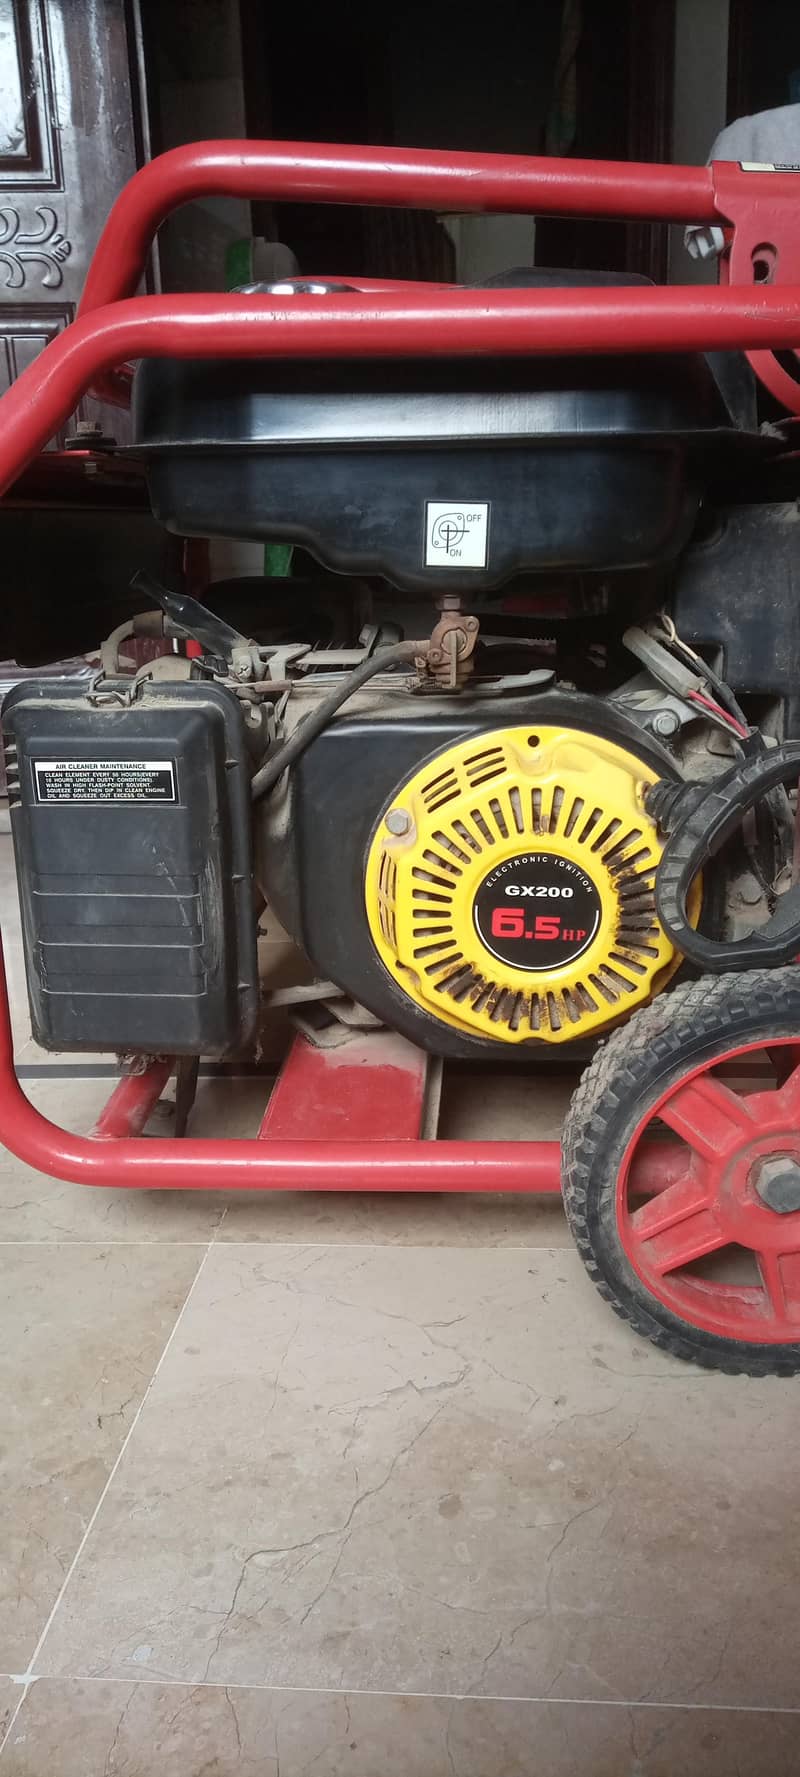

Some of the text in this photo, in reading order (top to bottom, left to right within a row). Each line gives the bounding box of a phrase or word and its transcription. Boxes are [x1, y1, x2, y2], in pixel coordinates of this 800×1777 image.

[466, 513, 482, 522] OFF
[449, 548, 462, 557] ON
[486, 856, 593, 893] ELECTRONIC IGNITION
[504, 885, 574, 898] GX200
[491, 907, 587, 941] 6.5 HP
